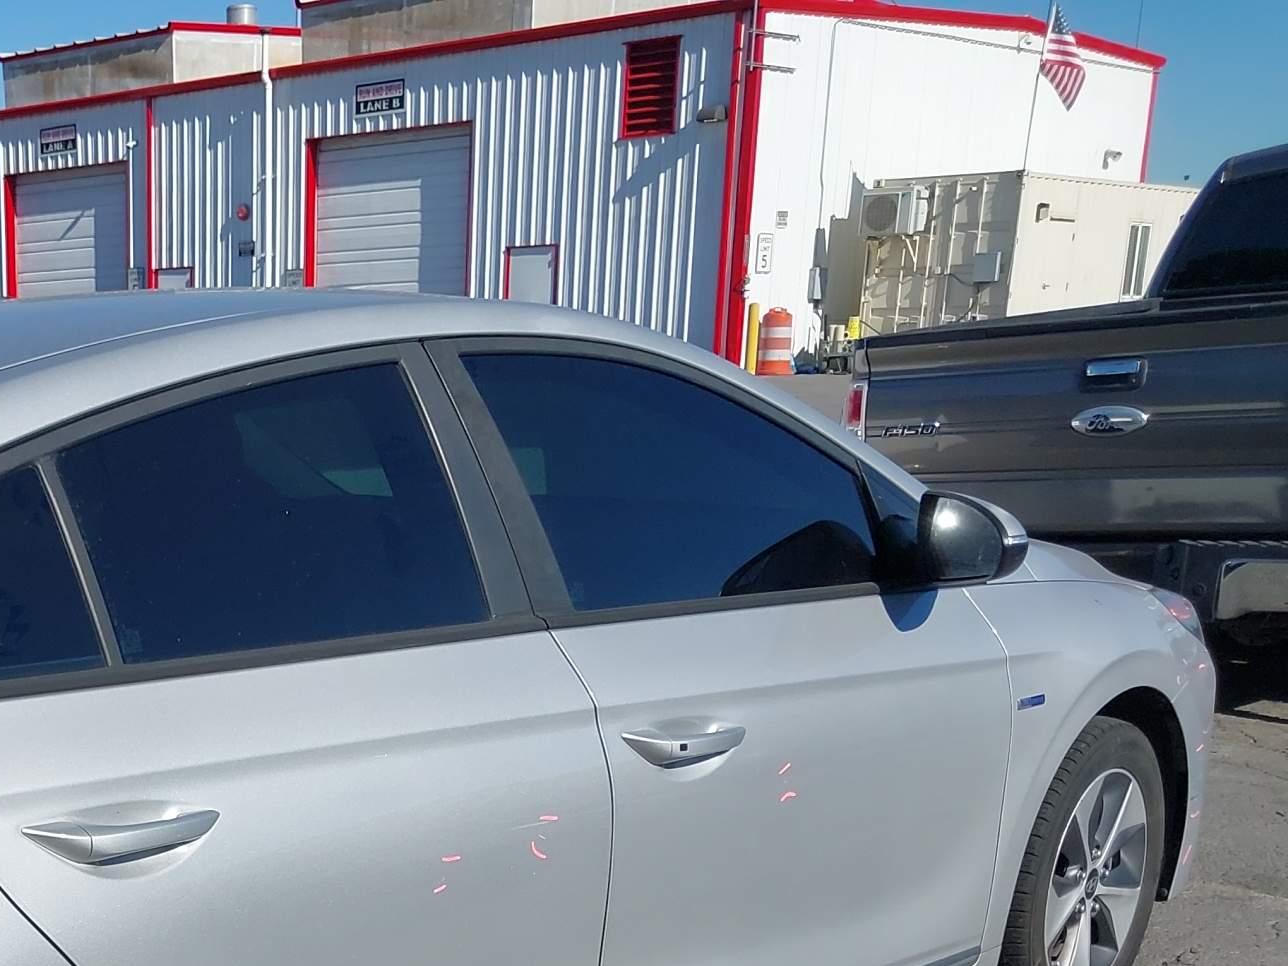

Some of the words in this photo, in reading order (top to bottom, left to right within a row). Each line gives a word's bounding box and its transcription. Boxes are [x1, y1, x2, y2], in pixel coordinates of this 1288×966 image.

[360, 99, 390, 113] LANE
[392, 97, 401, 109] B
[761, 254, 768, 269] 5
